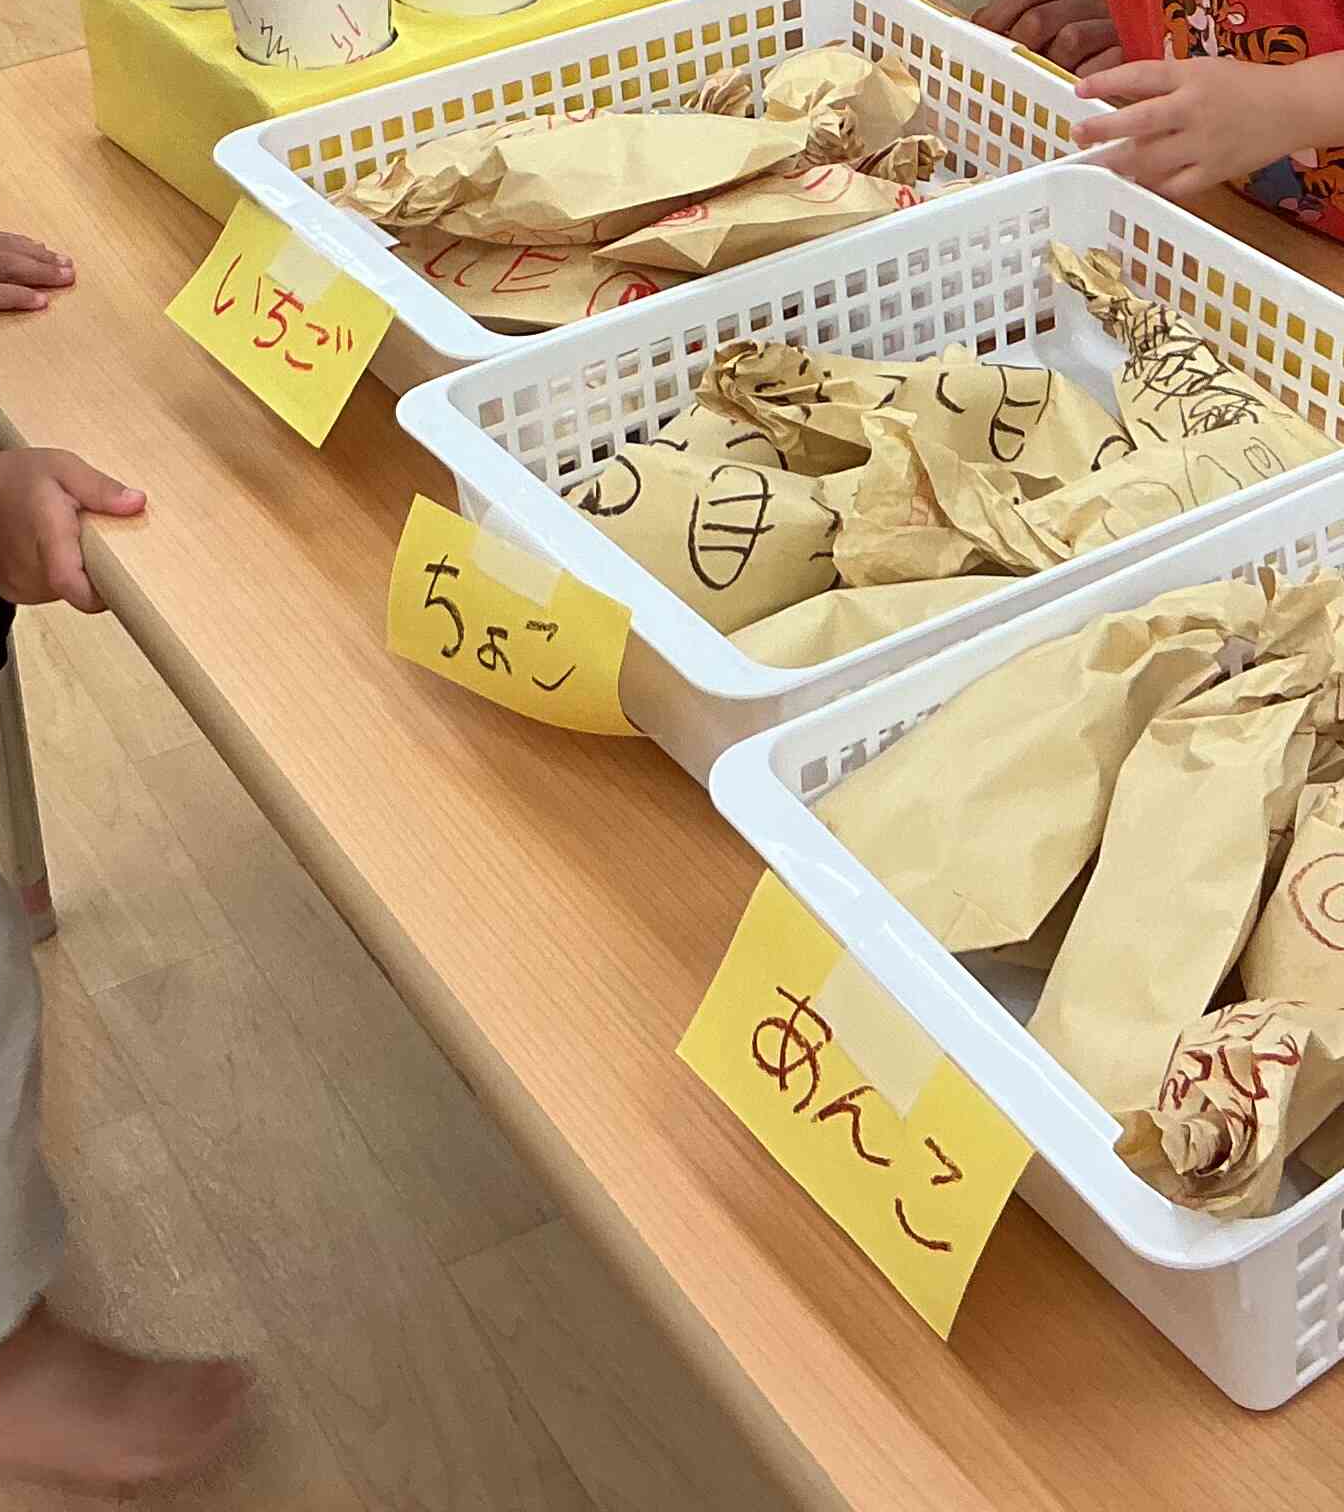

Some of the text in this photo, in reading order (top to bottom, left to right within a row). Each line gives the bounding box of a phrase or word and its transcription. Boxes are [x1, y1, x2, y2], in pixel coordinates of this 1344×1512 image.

[213, 253, 354, 372] いちご
[423, 553, 577, 692] ちょこ
[751, 986, 964, 1253] あんこ
